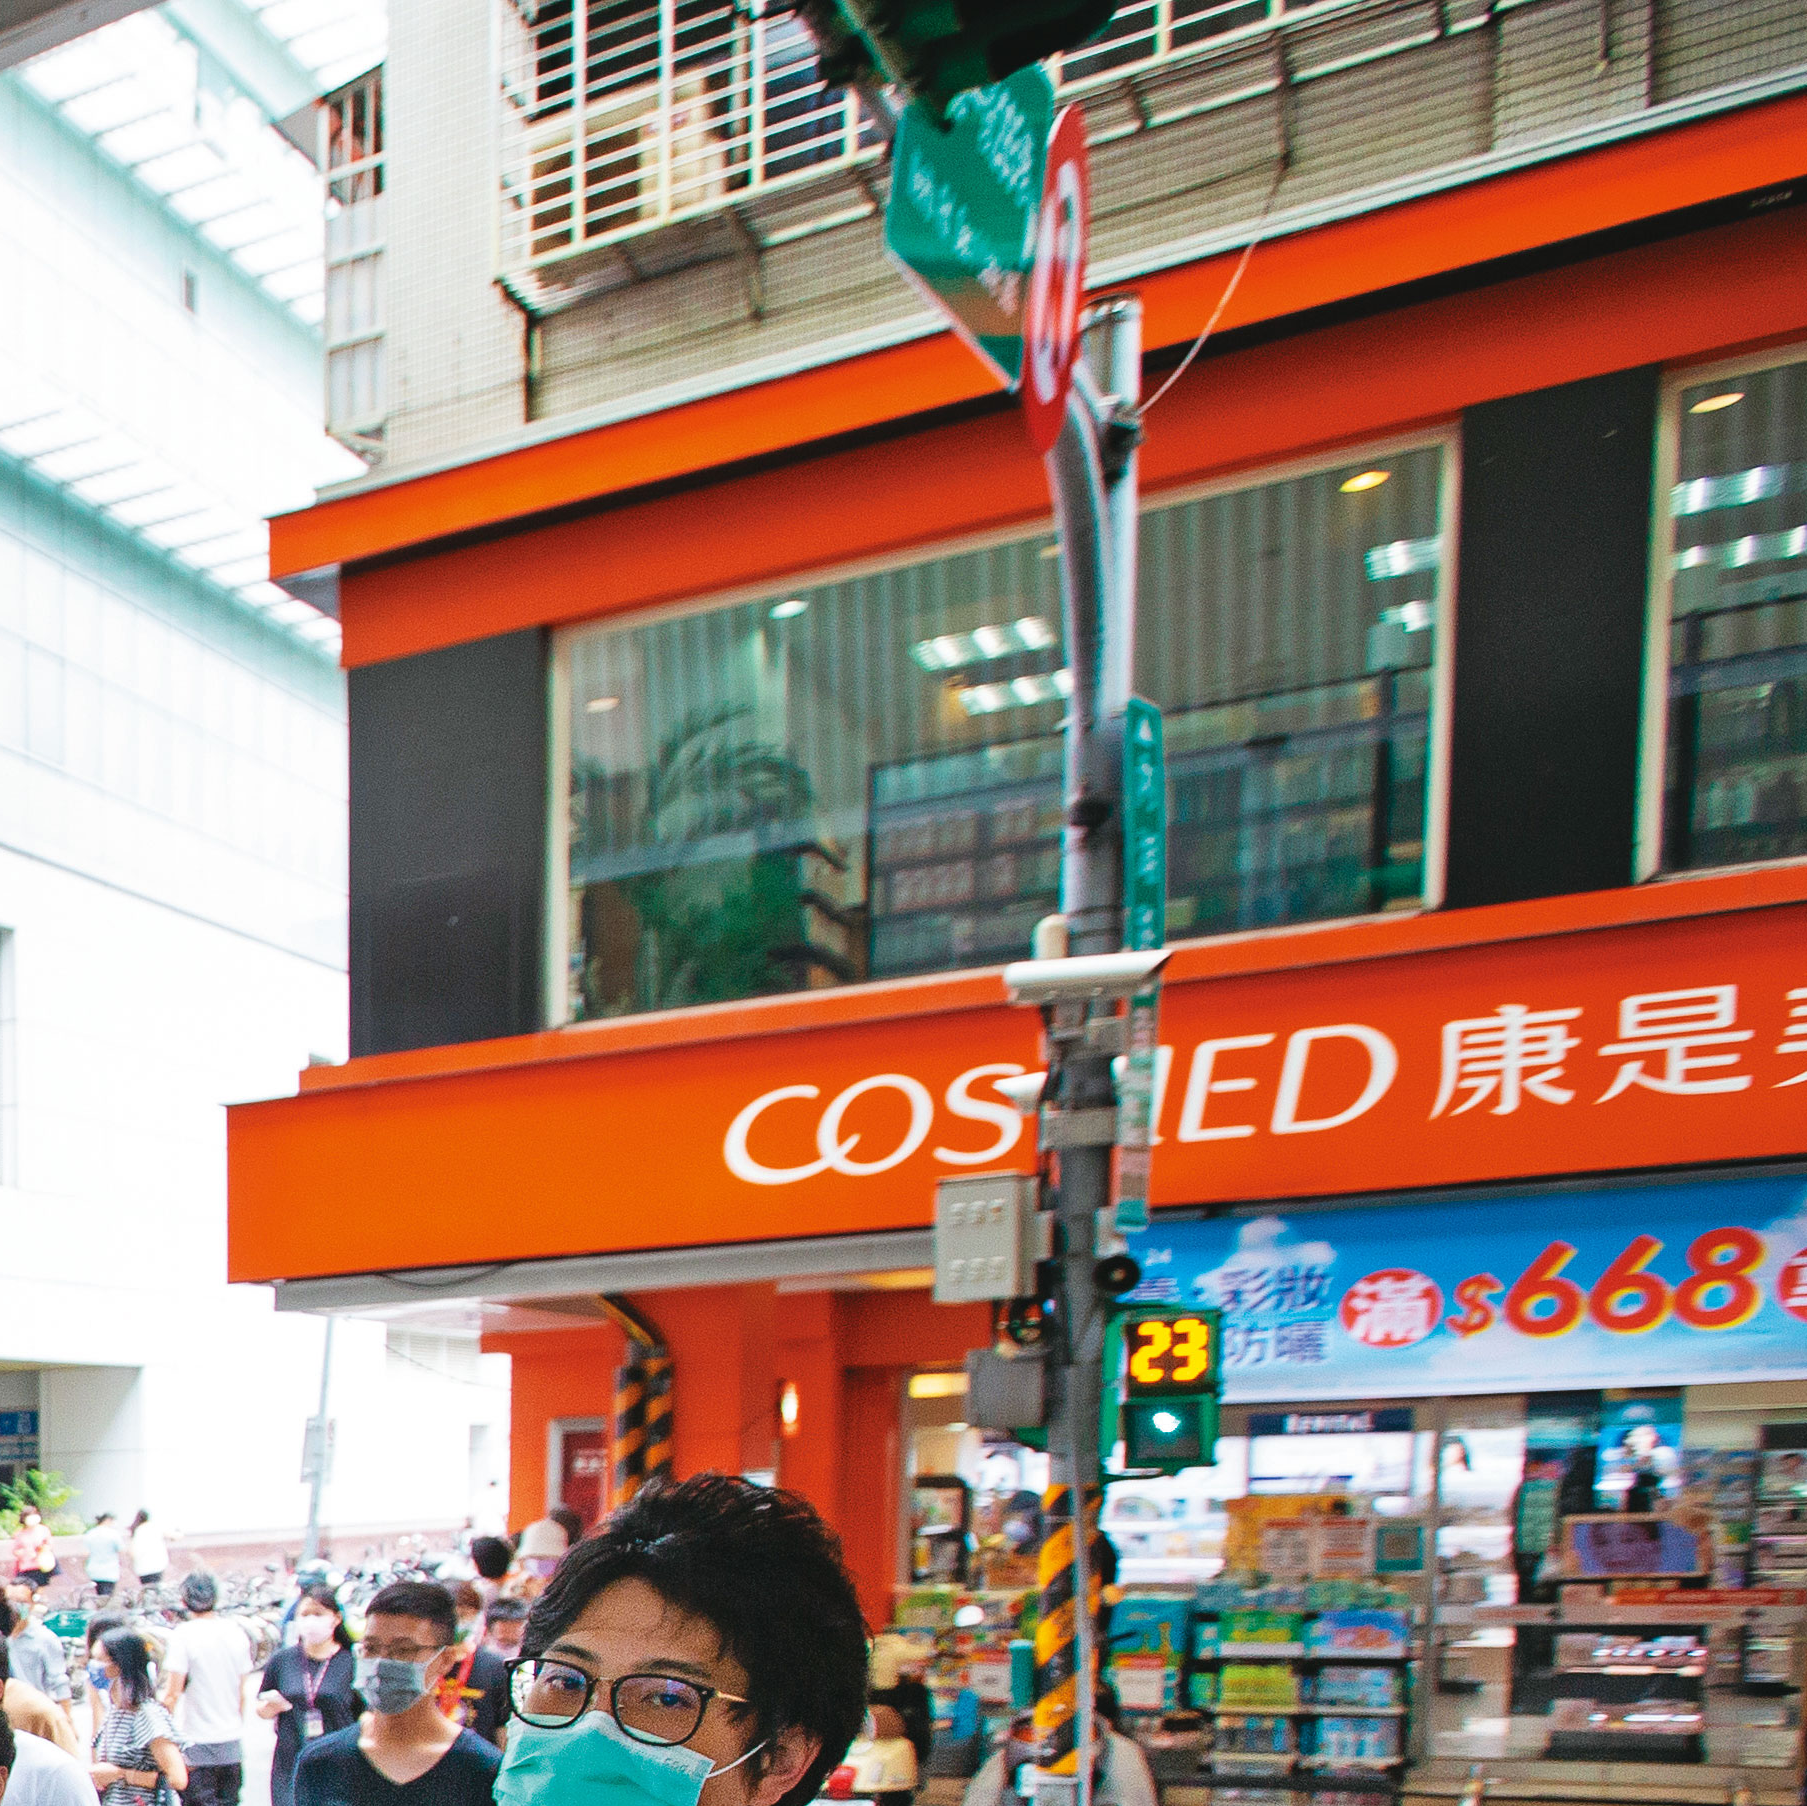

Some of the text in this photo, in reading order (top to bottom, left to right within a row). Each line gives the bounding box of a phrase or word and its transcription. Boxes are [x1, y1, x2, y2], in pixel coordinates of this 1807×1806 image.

[722, 1022, 1400, 1185] COSED
[1347, 1271, 1437, 1345] 滿
[1445, 1226, 1769, 1339] $668
[1129, 1318, 1210, 1384] 23
